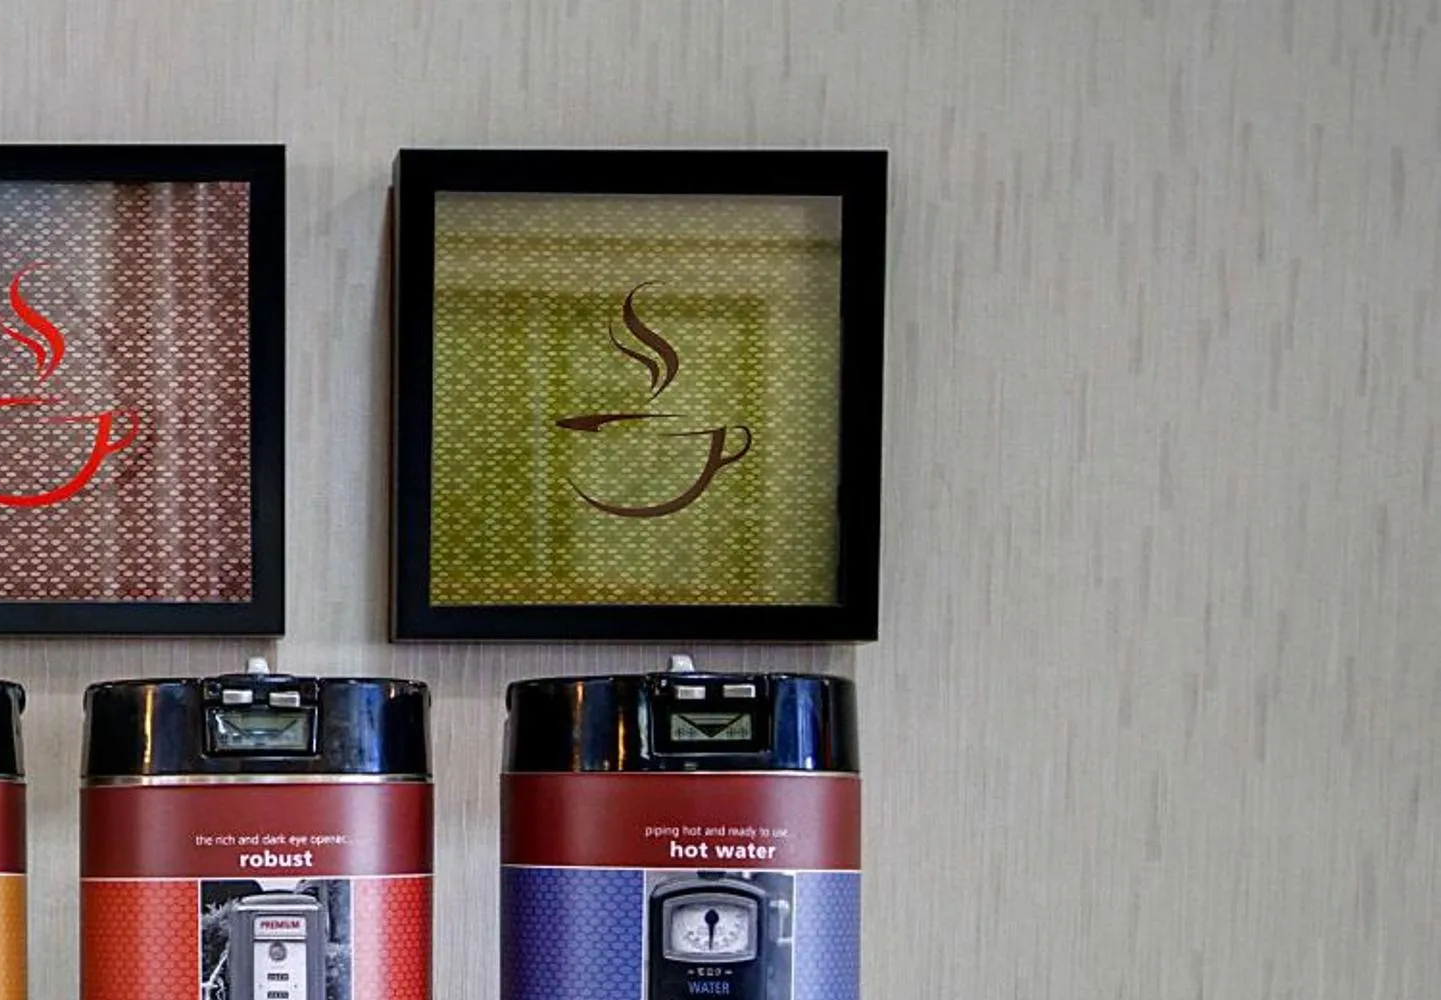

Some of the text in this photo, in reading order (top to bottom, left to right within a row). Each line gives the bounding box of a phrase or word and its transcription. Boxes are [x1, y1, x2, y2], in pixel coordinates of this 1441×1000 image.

[645, 826, 680, 838] piping
[682, 825, 702, 837] hot
[704, 825, 725, 837] and
[728, 826, 756, 839] ready
[759, 827, 770, 837] to
[196, 835, 212, 846] the
[215, 835, 236, 846] rich
[238, 834, 259, 846] and
[262, 834, 285, 846] dark
[288, 836, 307, 846] eye
[670, 841, 776, 859] hot water
[239, 849, 313, 868] robust
[260, 920, 301, 930] PREMIUM
[687, 981, 730, 995] WATER
